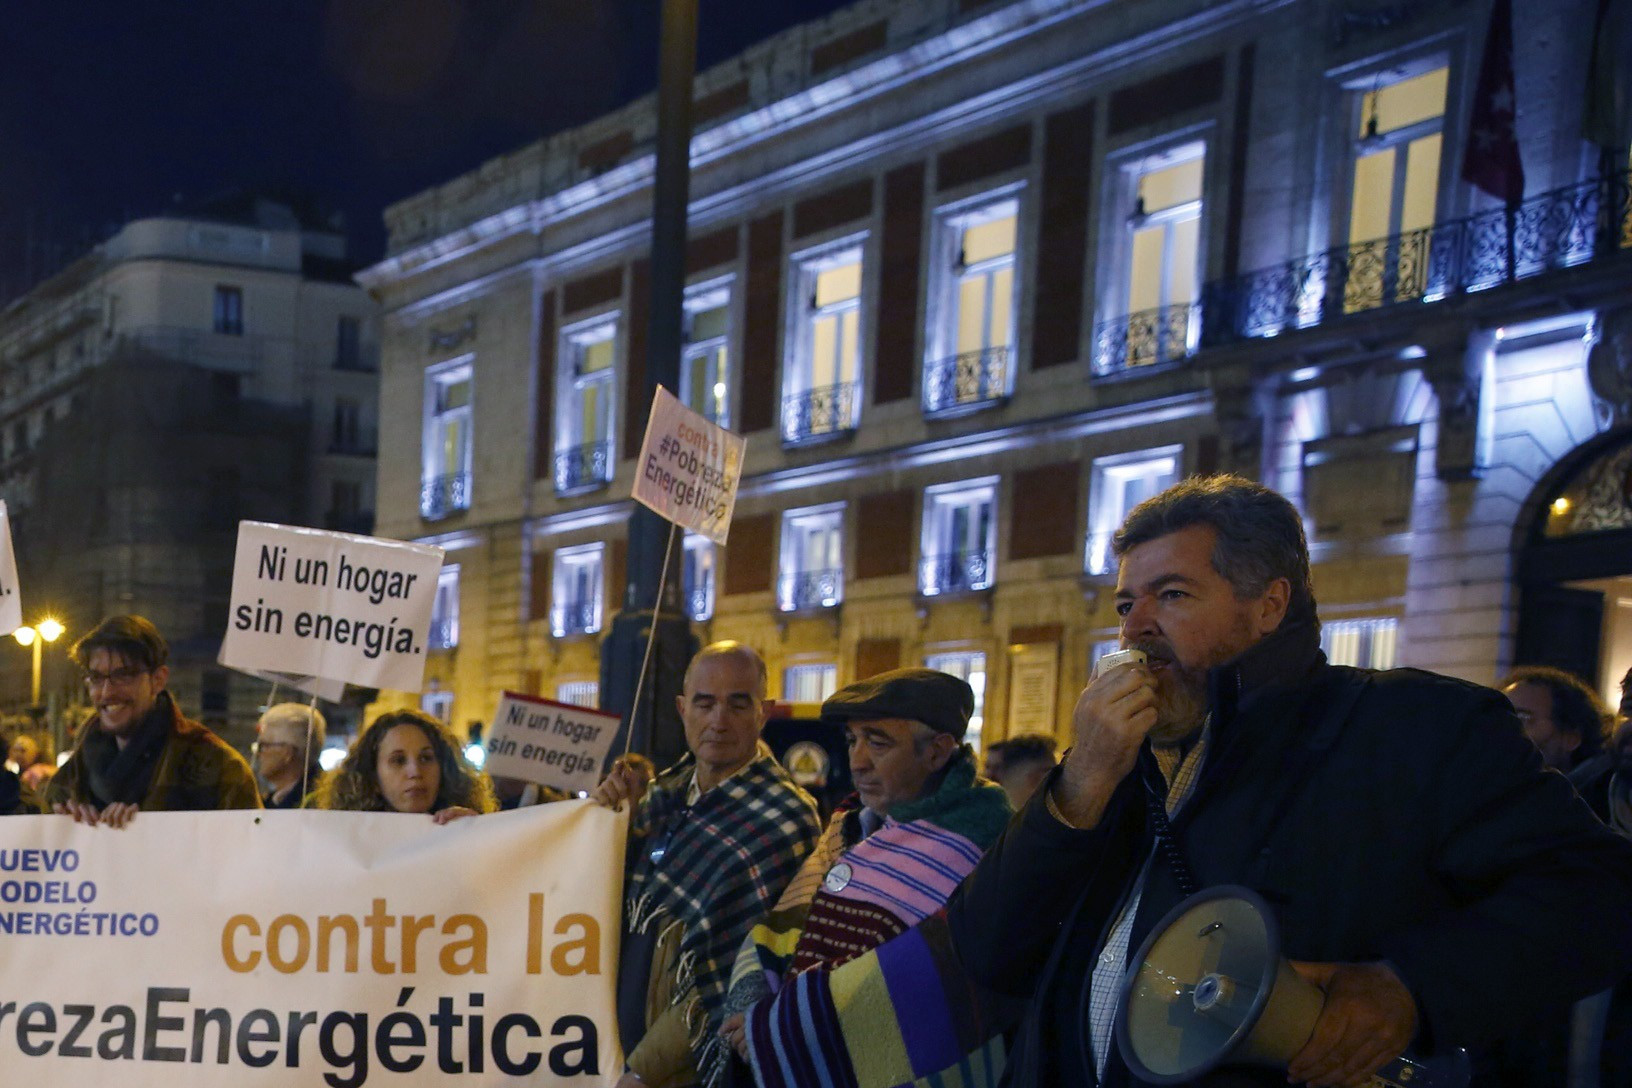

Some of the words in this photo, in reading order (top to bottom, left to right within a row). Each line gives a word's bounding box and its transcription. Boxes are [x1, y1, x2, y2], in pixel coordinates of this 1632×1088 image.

[258, 544, 287, 581] Ni
[294, 557, 328, 586] un
[337, 554, 417, 604] hogar
[235, 599, 283, 634] sin
[294, 611, 420, 659] energía.
[488, 735, 517, 757] sin
[506, 704, 527, 726] Ni
[527, 712, 550, 732] un
[552, 713, 601, 744] hogar
[220, 898, 489, 976] contra
[526, 892, 602, 976] la
